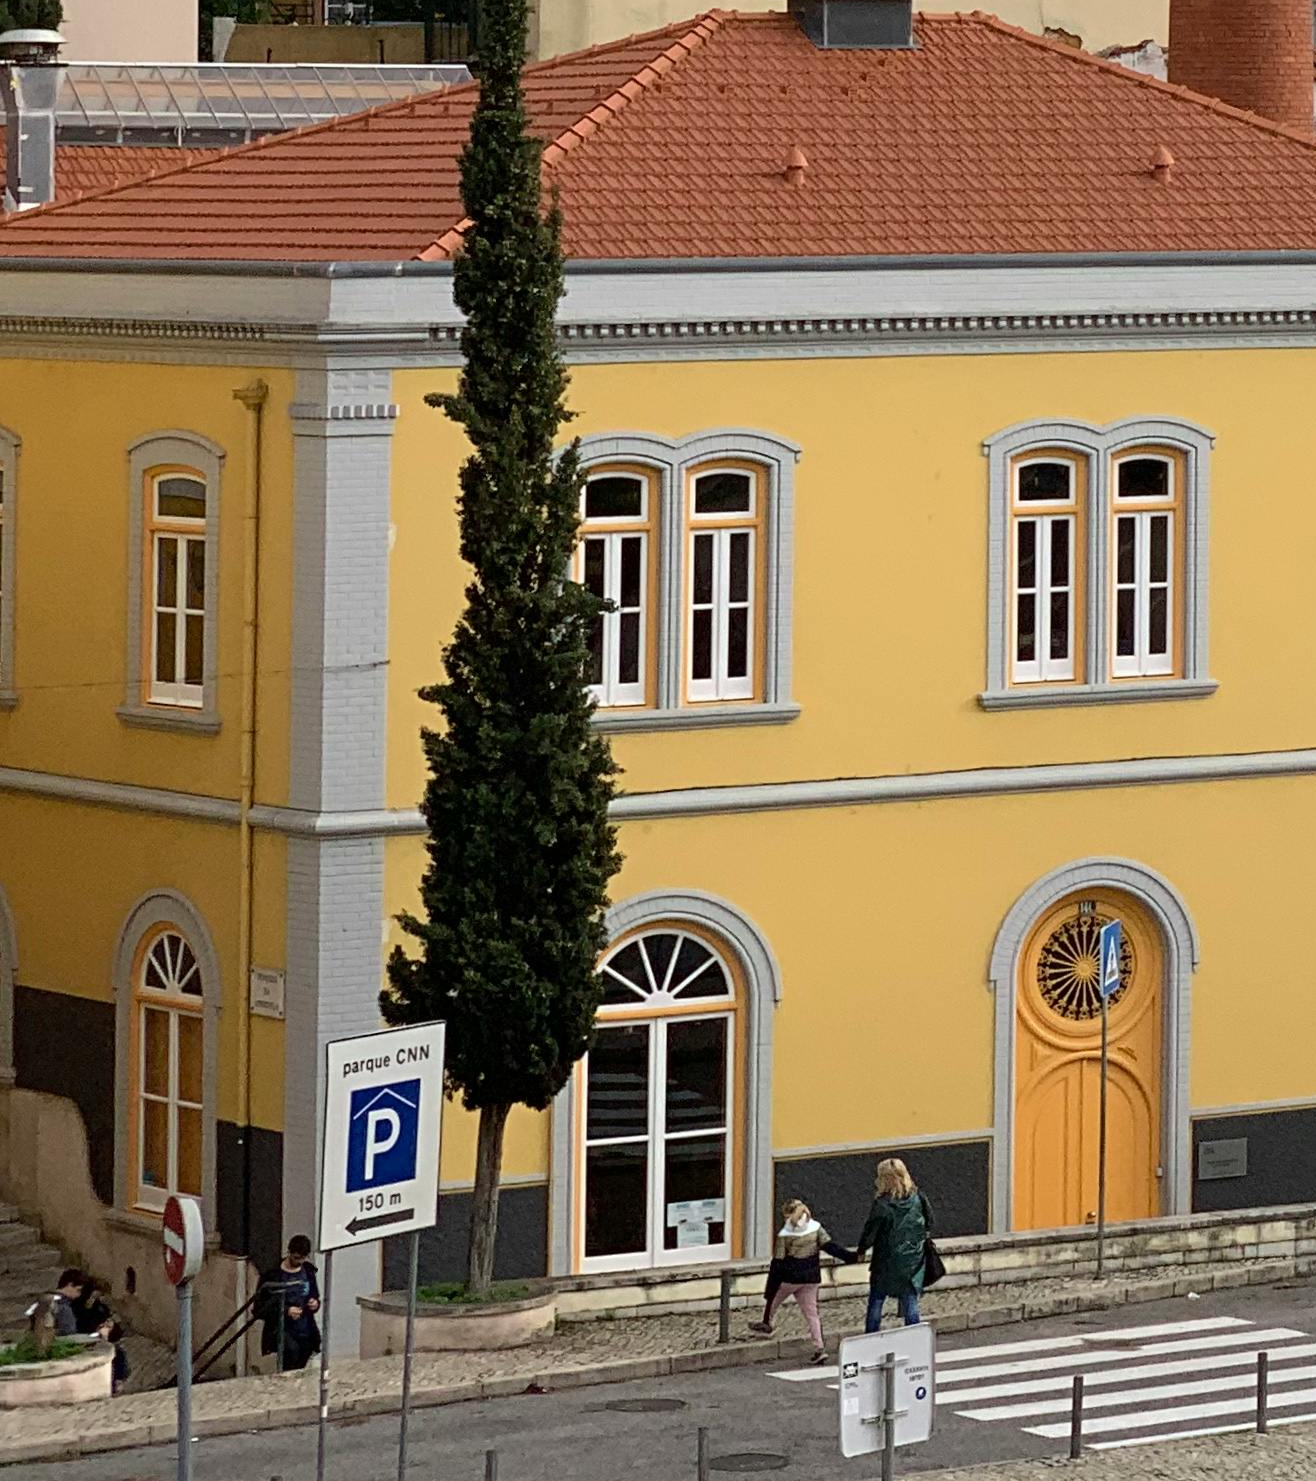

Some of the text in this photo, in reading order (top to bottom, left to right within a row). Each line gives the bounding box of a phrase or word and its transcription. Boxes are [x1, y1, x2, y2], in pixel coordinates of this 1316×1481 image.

[343, 1044, 430, 1078] parque CNN
[364, 1107, 401, 1181] P
[358, 1191, 401, 1212] 150 m
